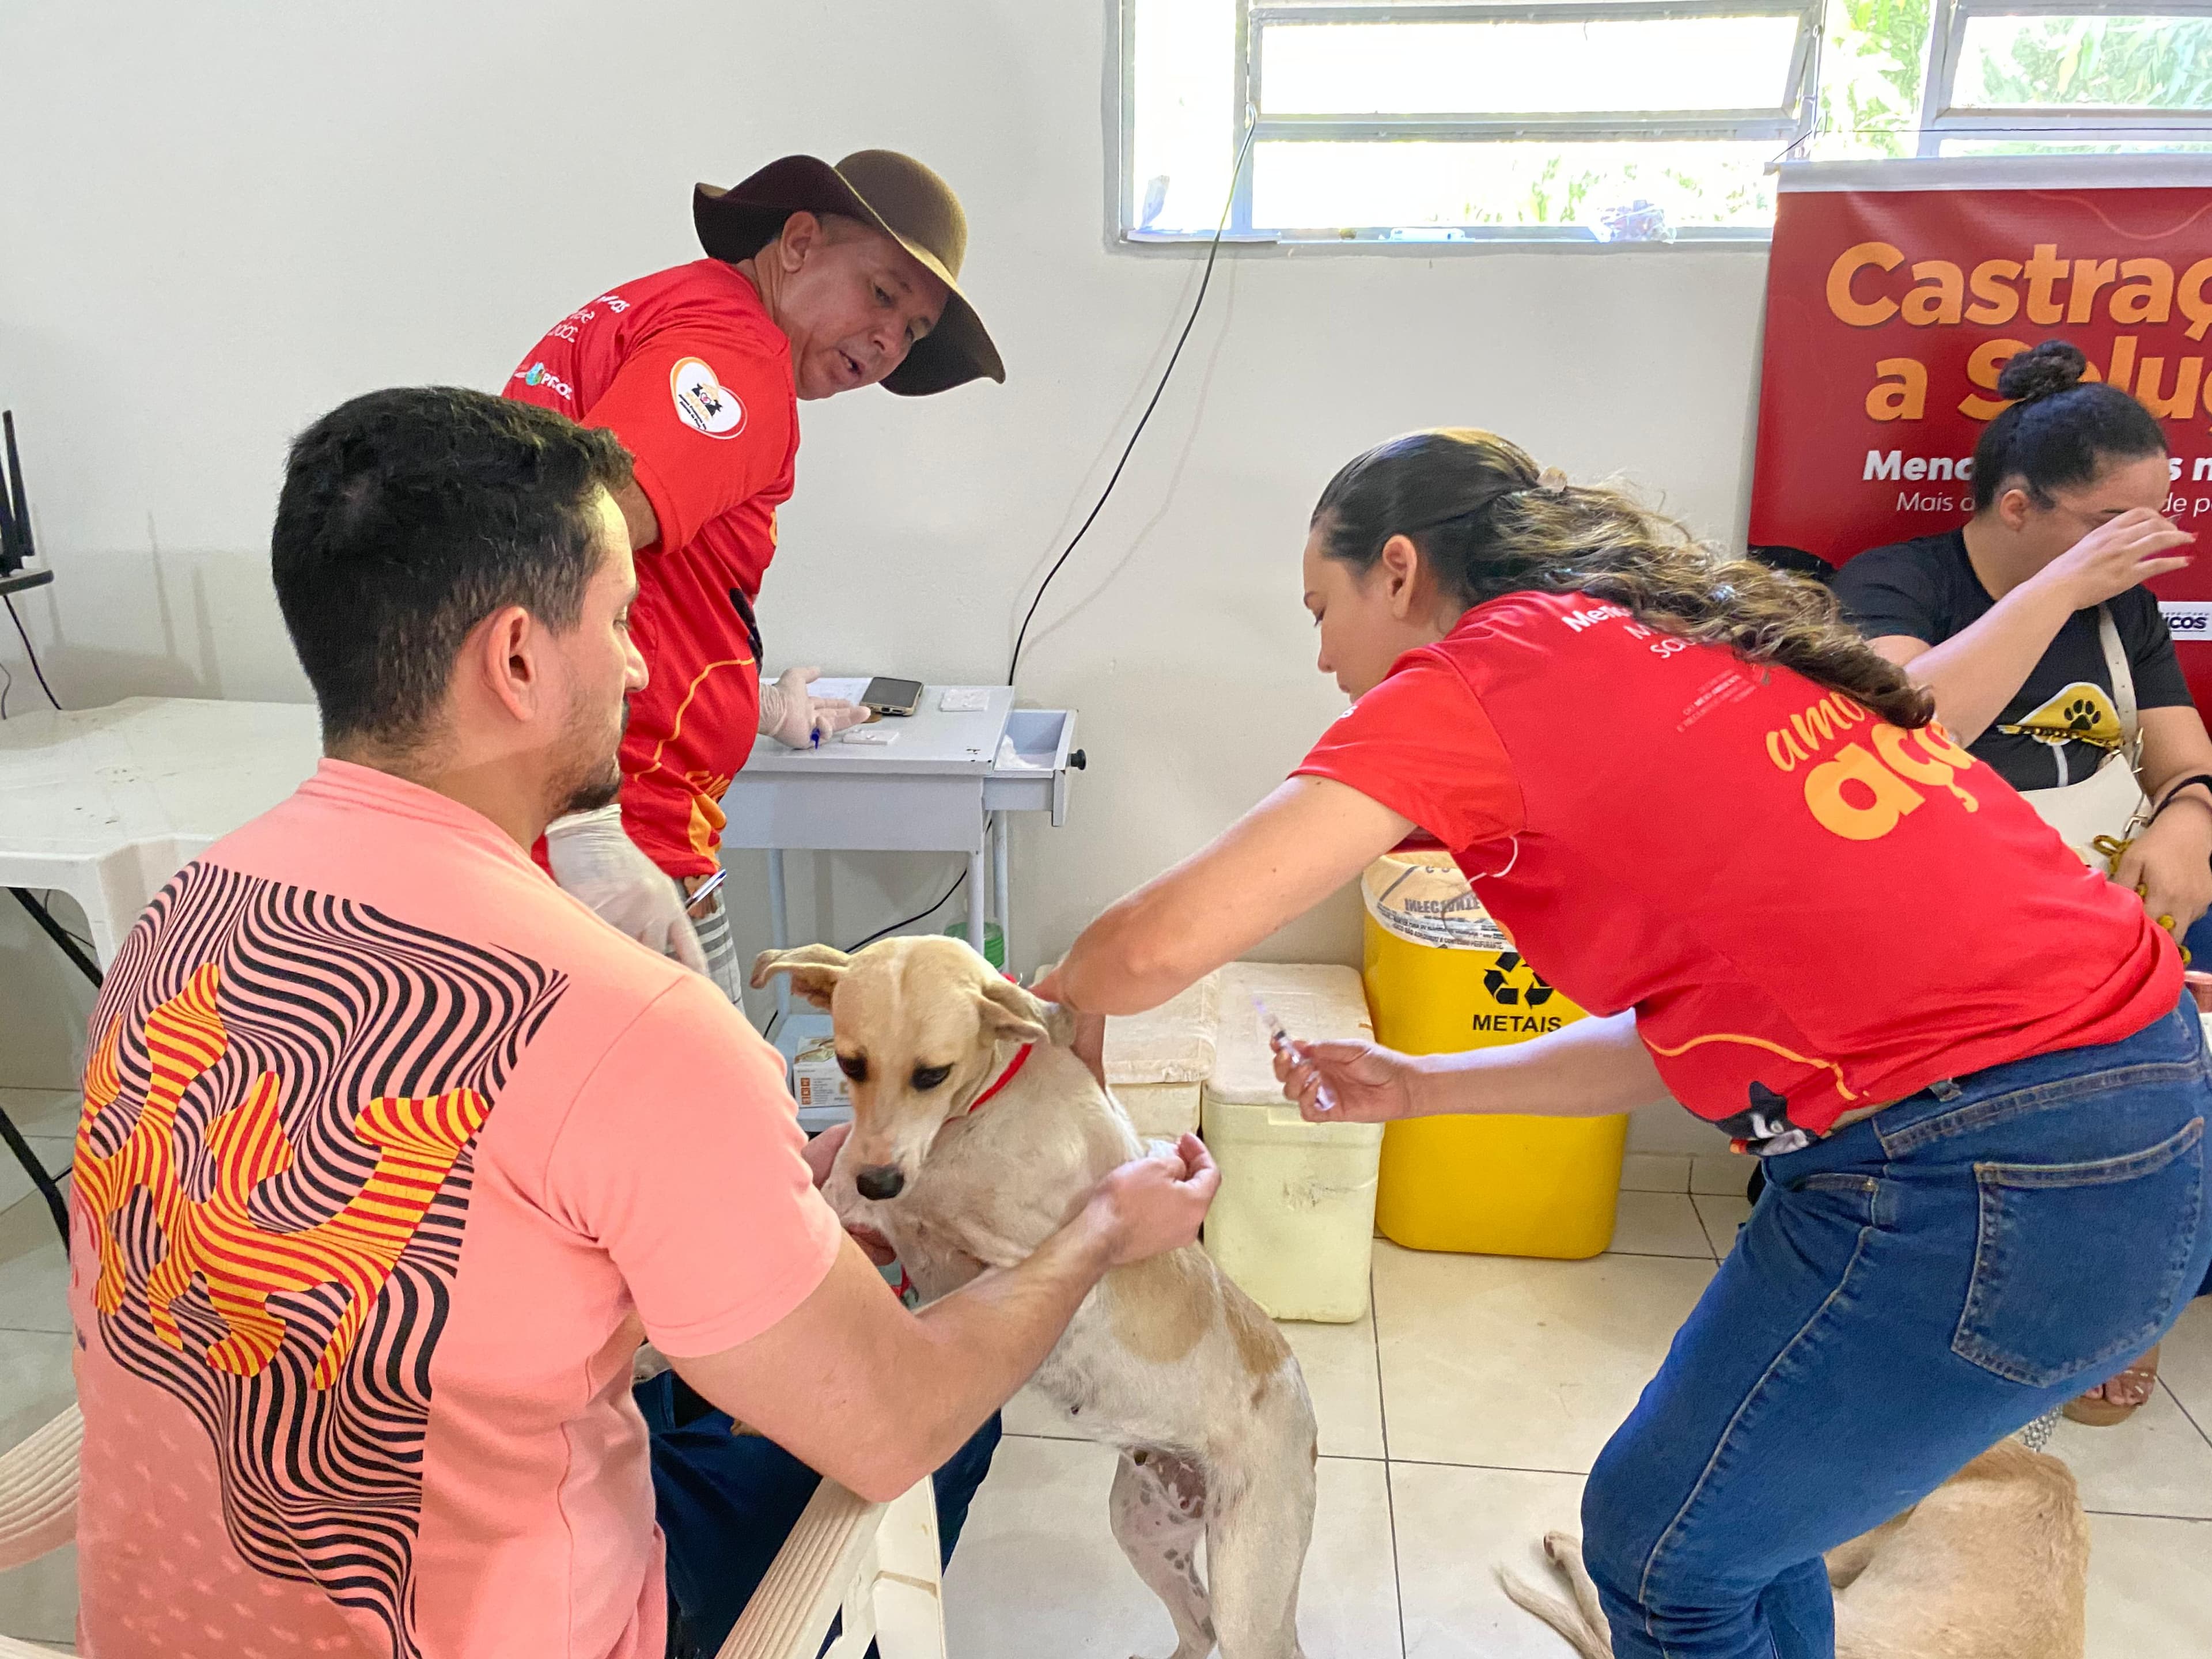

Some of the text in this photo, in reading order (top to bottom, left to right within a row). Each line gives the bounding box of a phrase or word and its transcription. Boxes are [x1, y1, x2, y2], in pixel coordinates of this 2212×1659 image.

[1865, 357, 1929, 421] a
[1896, 491, 1954, 512] Mais
[1472, 1014, 1562, 1032] METAIS
